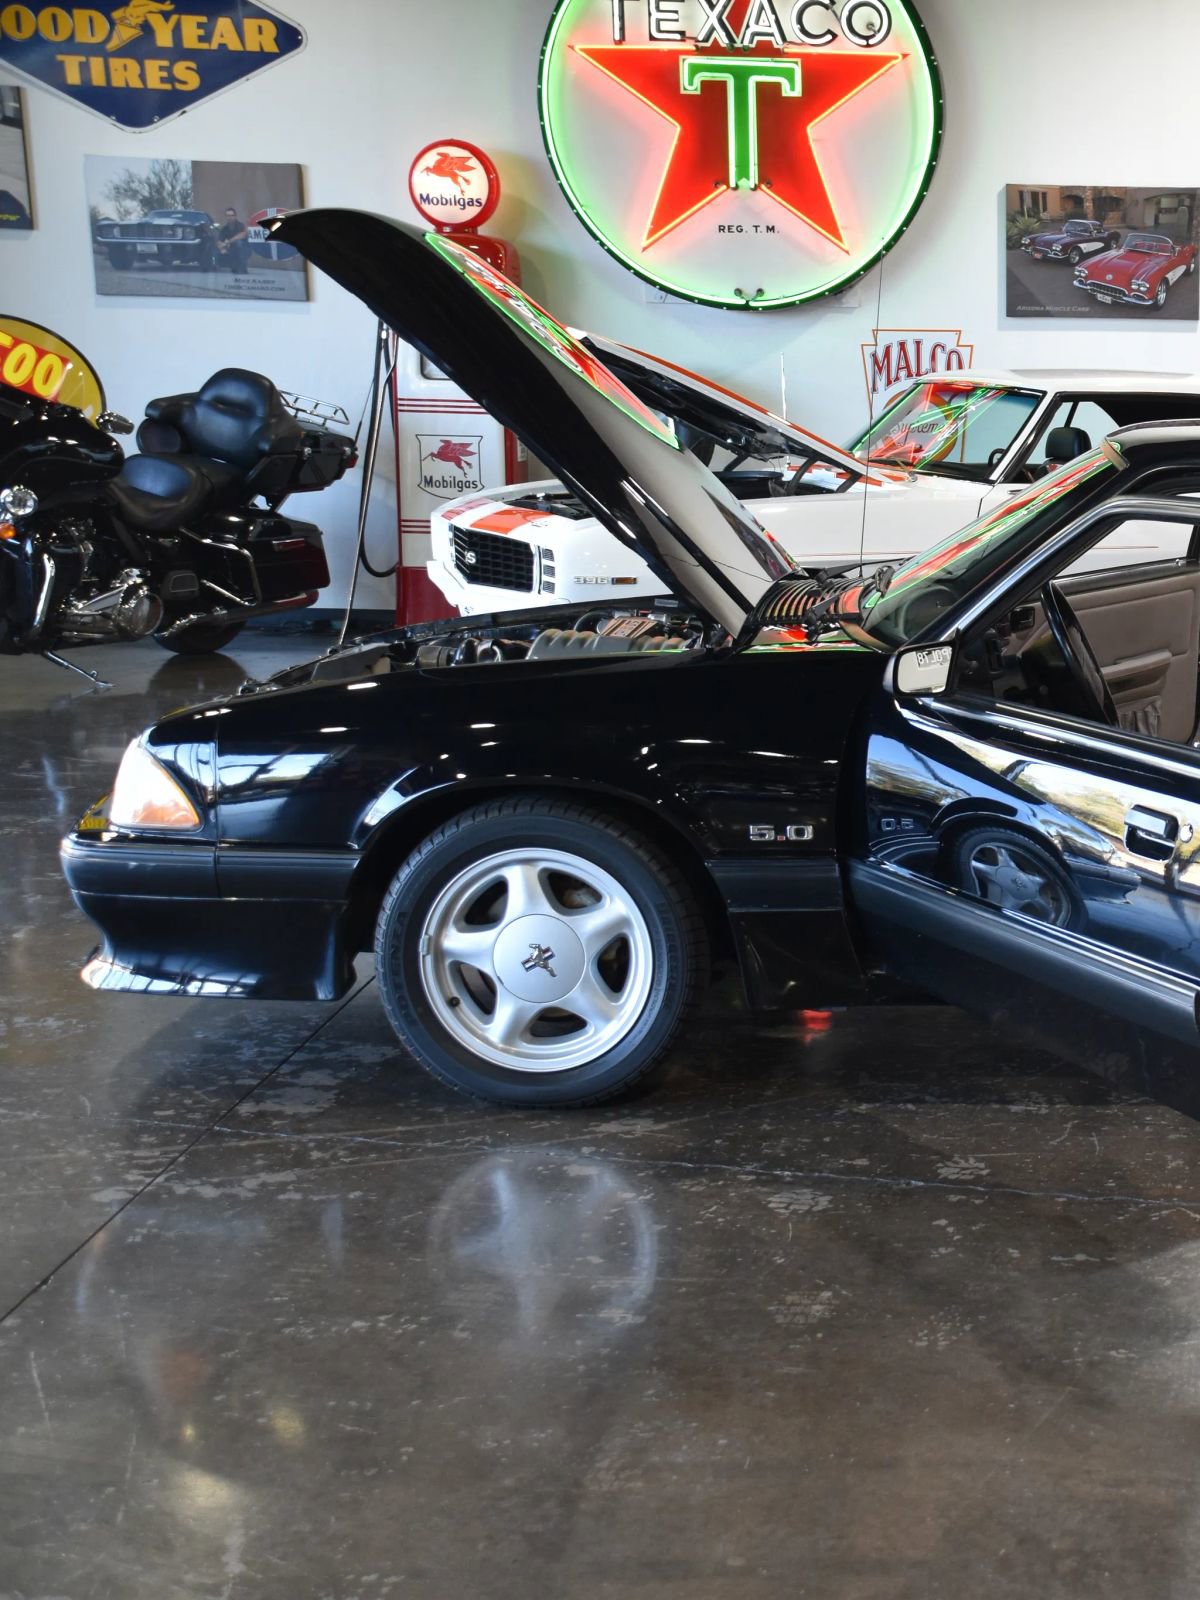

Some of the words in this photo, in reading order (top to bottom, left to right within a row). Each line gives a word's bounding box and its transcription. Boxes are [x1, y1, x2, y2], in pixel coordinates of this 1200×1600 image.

[0, 5, 110, 44] OOD
[599, 0, 892, 47] TEXACO
[56, 54, 201, 91] TIRES
[419, 193, 483, 211] Mobilgas
[718, 224, 749, 234] REG.
[870, 339, 965, 394] MALCO
[423, 475, 479, 493] Mobilgas
[574, 576, 609, 585] 396
[749, 825, 813, 841] 5.0
